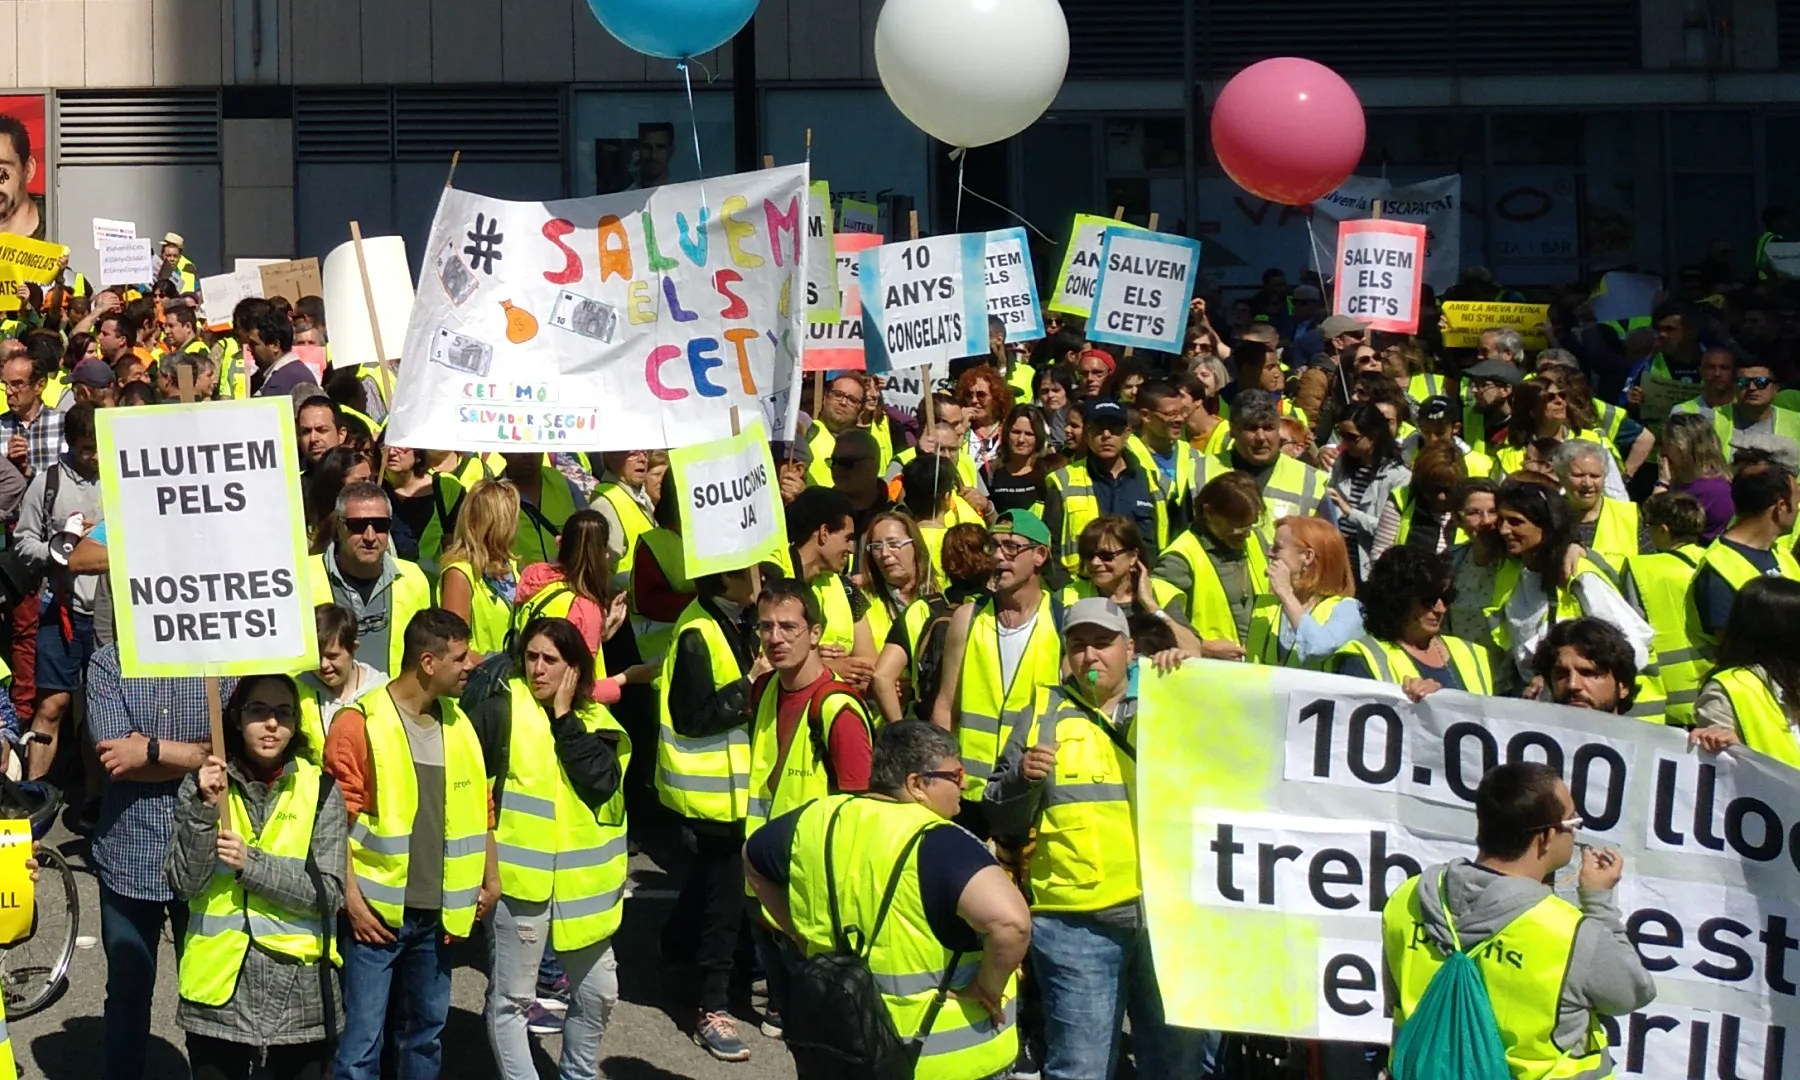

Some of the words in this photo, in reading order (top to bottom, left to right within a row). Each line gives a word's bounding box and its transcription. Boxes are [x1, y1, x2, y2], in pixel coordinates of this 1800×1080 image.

[542, 195, 801, 285] SALVEM
[15, 250, 57, 271] CONGELATS
[901, 245, 931, 271] 10
[1108, 253, 1186, 282] SALVEM
[1344, 248, 1413, 269] SALVEM
[1358, 270, 1393, 290] ELS
[627, 268, 749, 326] ELS
[884, 276, 955, 310] ANYS
[1123, 285, 1162, 309] ELS
[1348, 295, 1399, 316] CET'S
[1448, 303, 1470, 311] AMB
[1471, 303, 1483, 311] LA
[1485, 304, 1511, 313] MEVA
[1513, 304, 1541, 314] FEINA
[1461, 313, 1474, 322] NO
[1107, 311, 1165, 336] CET'S
[462, 382, 497, 398] CET
[459, 406, 534, 425] SALVADOR
[119, 439, 277, 479] LLUITEM
[156, 482, 246, 515] PELS
[740, 504, 757, 529] JA
[129, 568, 294, 605] NOSTRES
[153, 608, 277, 642] DRETS!
[1657, 760, 1800, 863] llo
[1209, 822, 1422, 913] treb
[1627, 907, 1798, 996] est
